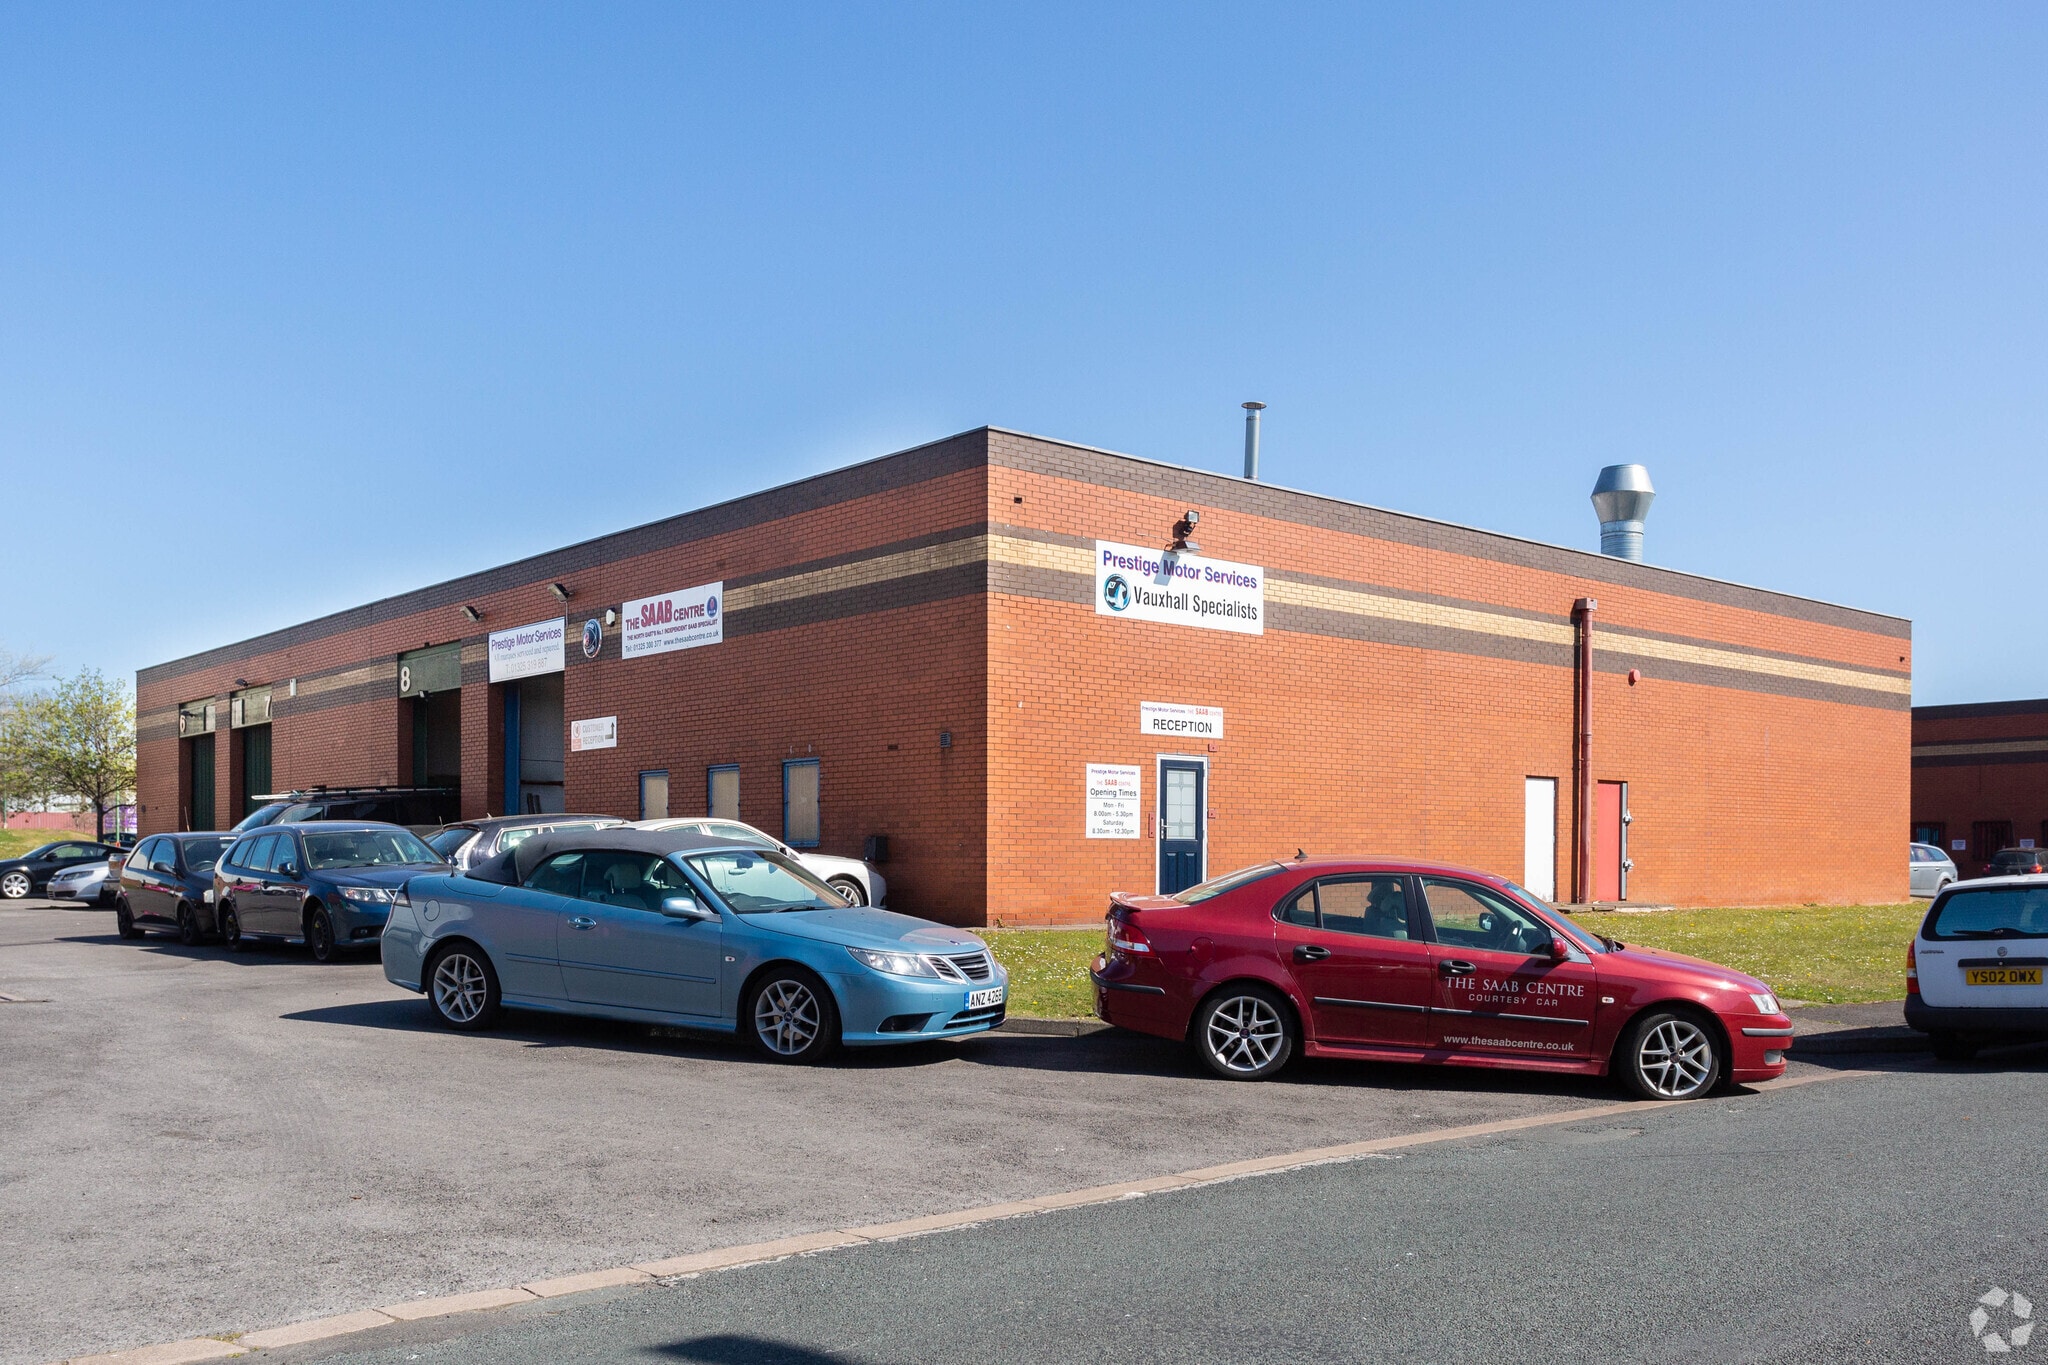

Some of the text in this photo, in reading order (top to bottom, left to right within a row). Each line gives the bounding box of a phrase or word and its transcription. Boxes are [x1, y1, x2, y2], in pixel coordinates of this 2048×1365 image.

[1103, 550, 1258, 589] Prestige Motor Services
[1134, 586, 1258, 620] Vauxhall Specialists
[626, 600, 704, 631] THE SAAB CENTRE
[664, 625, 688, 635] INDEPENDENT
[688, 622, 697, 630] SAAB
[698, 619, 718, 628] SPECIALIST
[491, 628, 562, 652] Prestige Motor Services
[633, 642, 646, 651] 01325
[664, 630, 719, 646] www.thesaabcentre.co.uk
[401, 666, 410, 692] 8
[265, 695, 271, 717] 7
[180, 715, 186, 732] 6
[1153, 718, 1212, 733] RECEPTION
[583, 735, 604, 745] RECEPTION
[1090, 787, 1137, 797] Opening Times
[1972, 970, 2006, 983] YS02
[1445, 976, 1584, 997] THE SAAB CENTRE
[970, 993, 986, 1007] ANZ
[1469, 993, 1558, 1007] COURTESY CAR
[1444, 1035, 1574, 1051] www.thesaabcentre.co.uk
